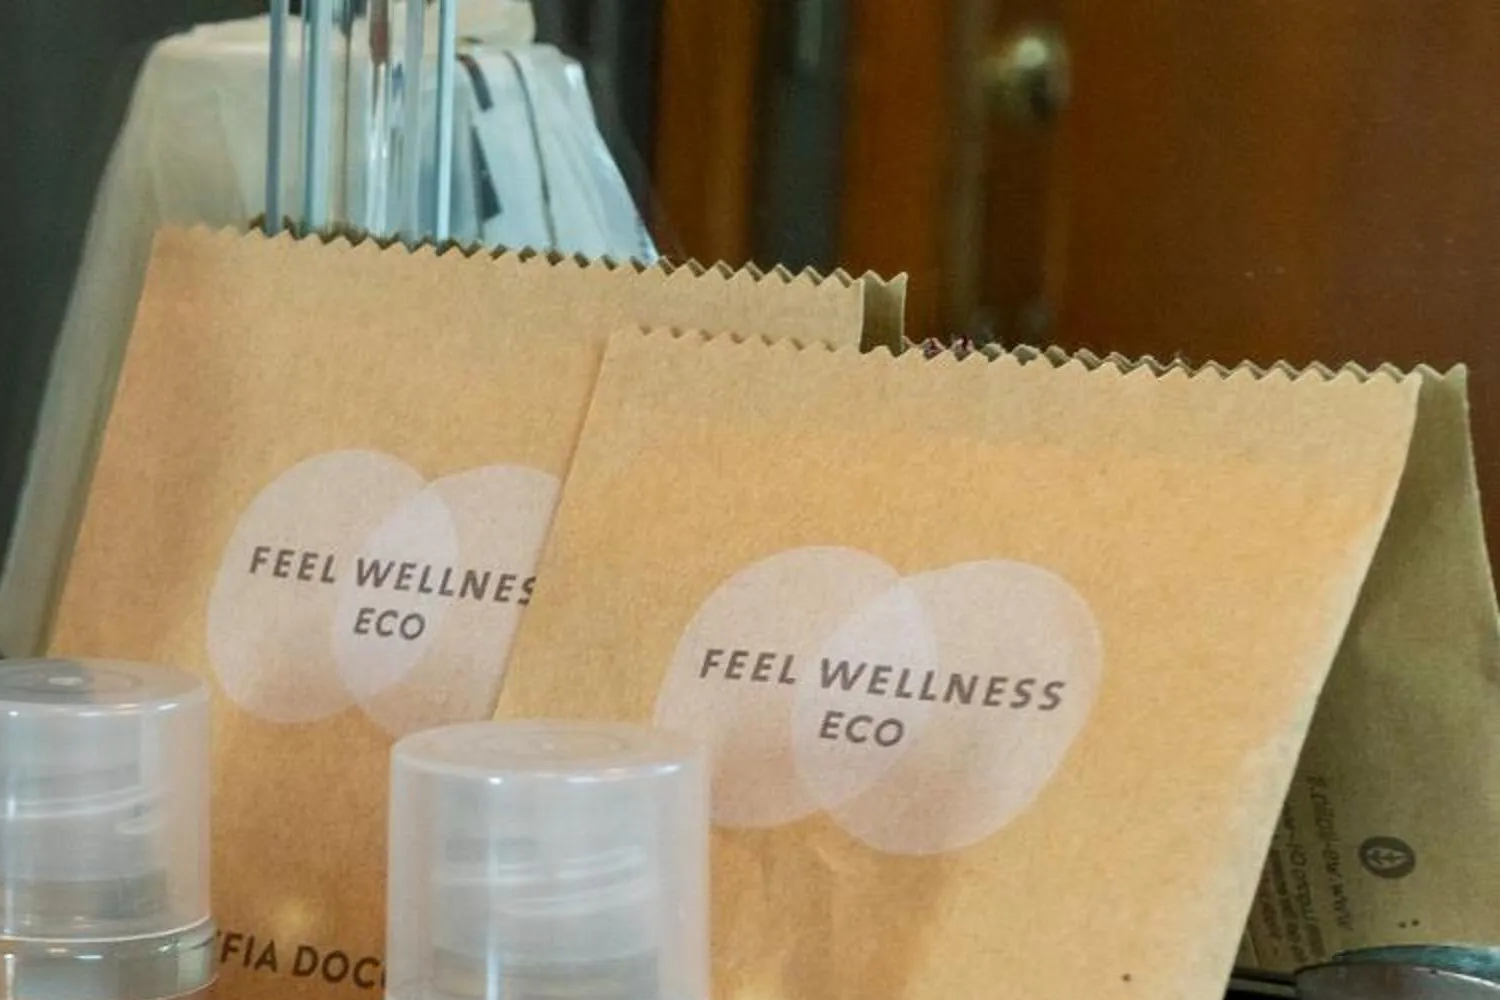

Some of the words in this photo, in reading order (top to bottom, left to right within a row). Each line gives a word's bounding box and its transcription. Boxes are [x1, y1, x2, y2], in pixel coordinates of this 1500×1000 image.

[248, 545, 337, 585] FEEL
[355, 556, 538, 606] WELLNES
[353, 606, 426, 640] ECO
[698, 648, 798, 685] FEEL
[818, 656, 1066, 712] WELLNESS
[818, 709, 906, 748] ECO
[215, 928, 279, 974] FIA
[291, 944, 387, 990] DOC
